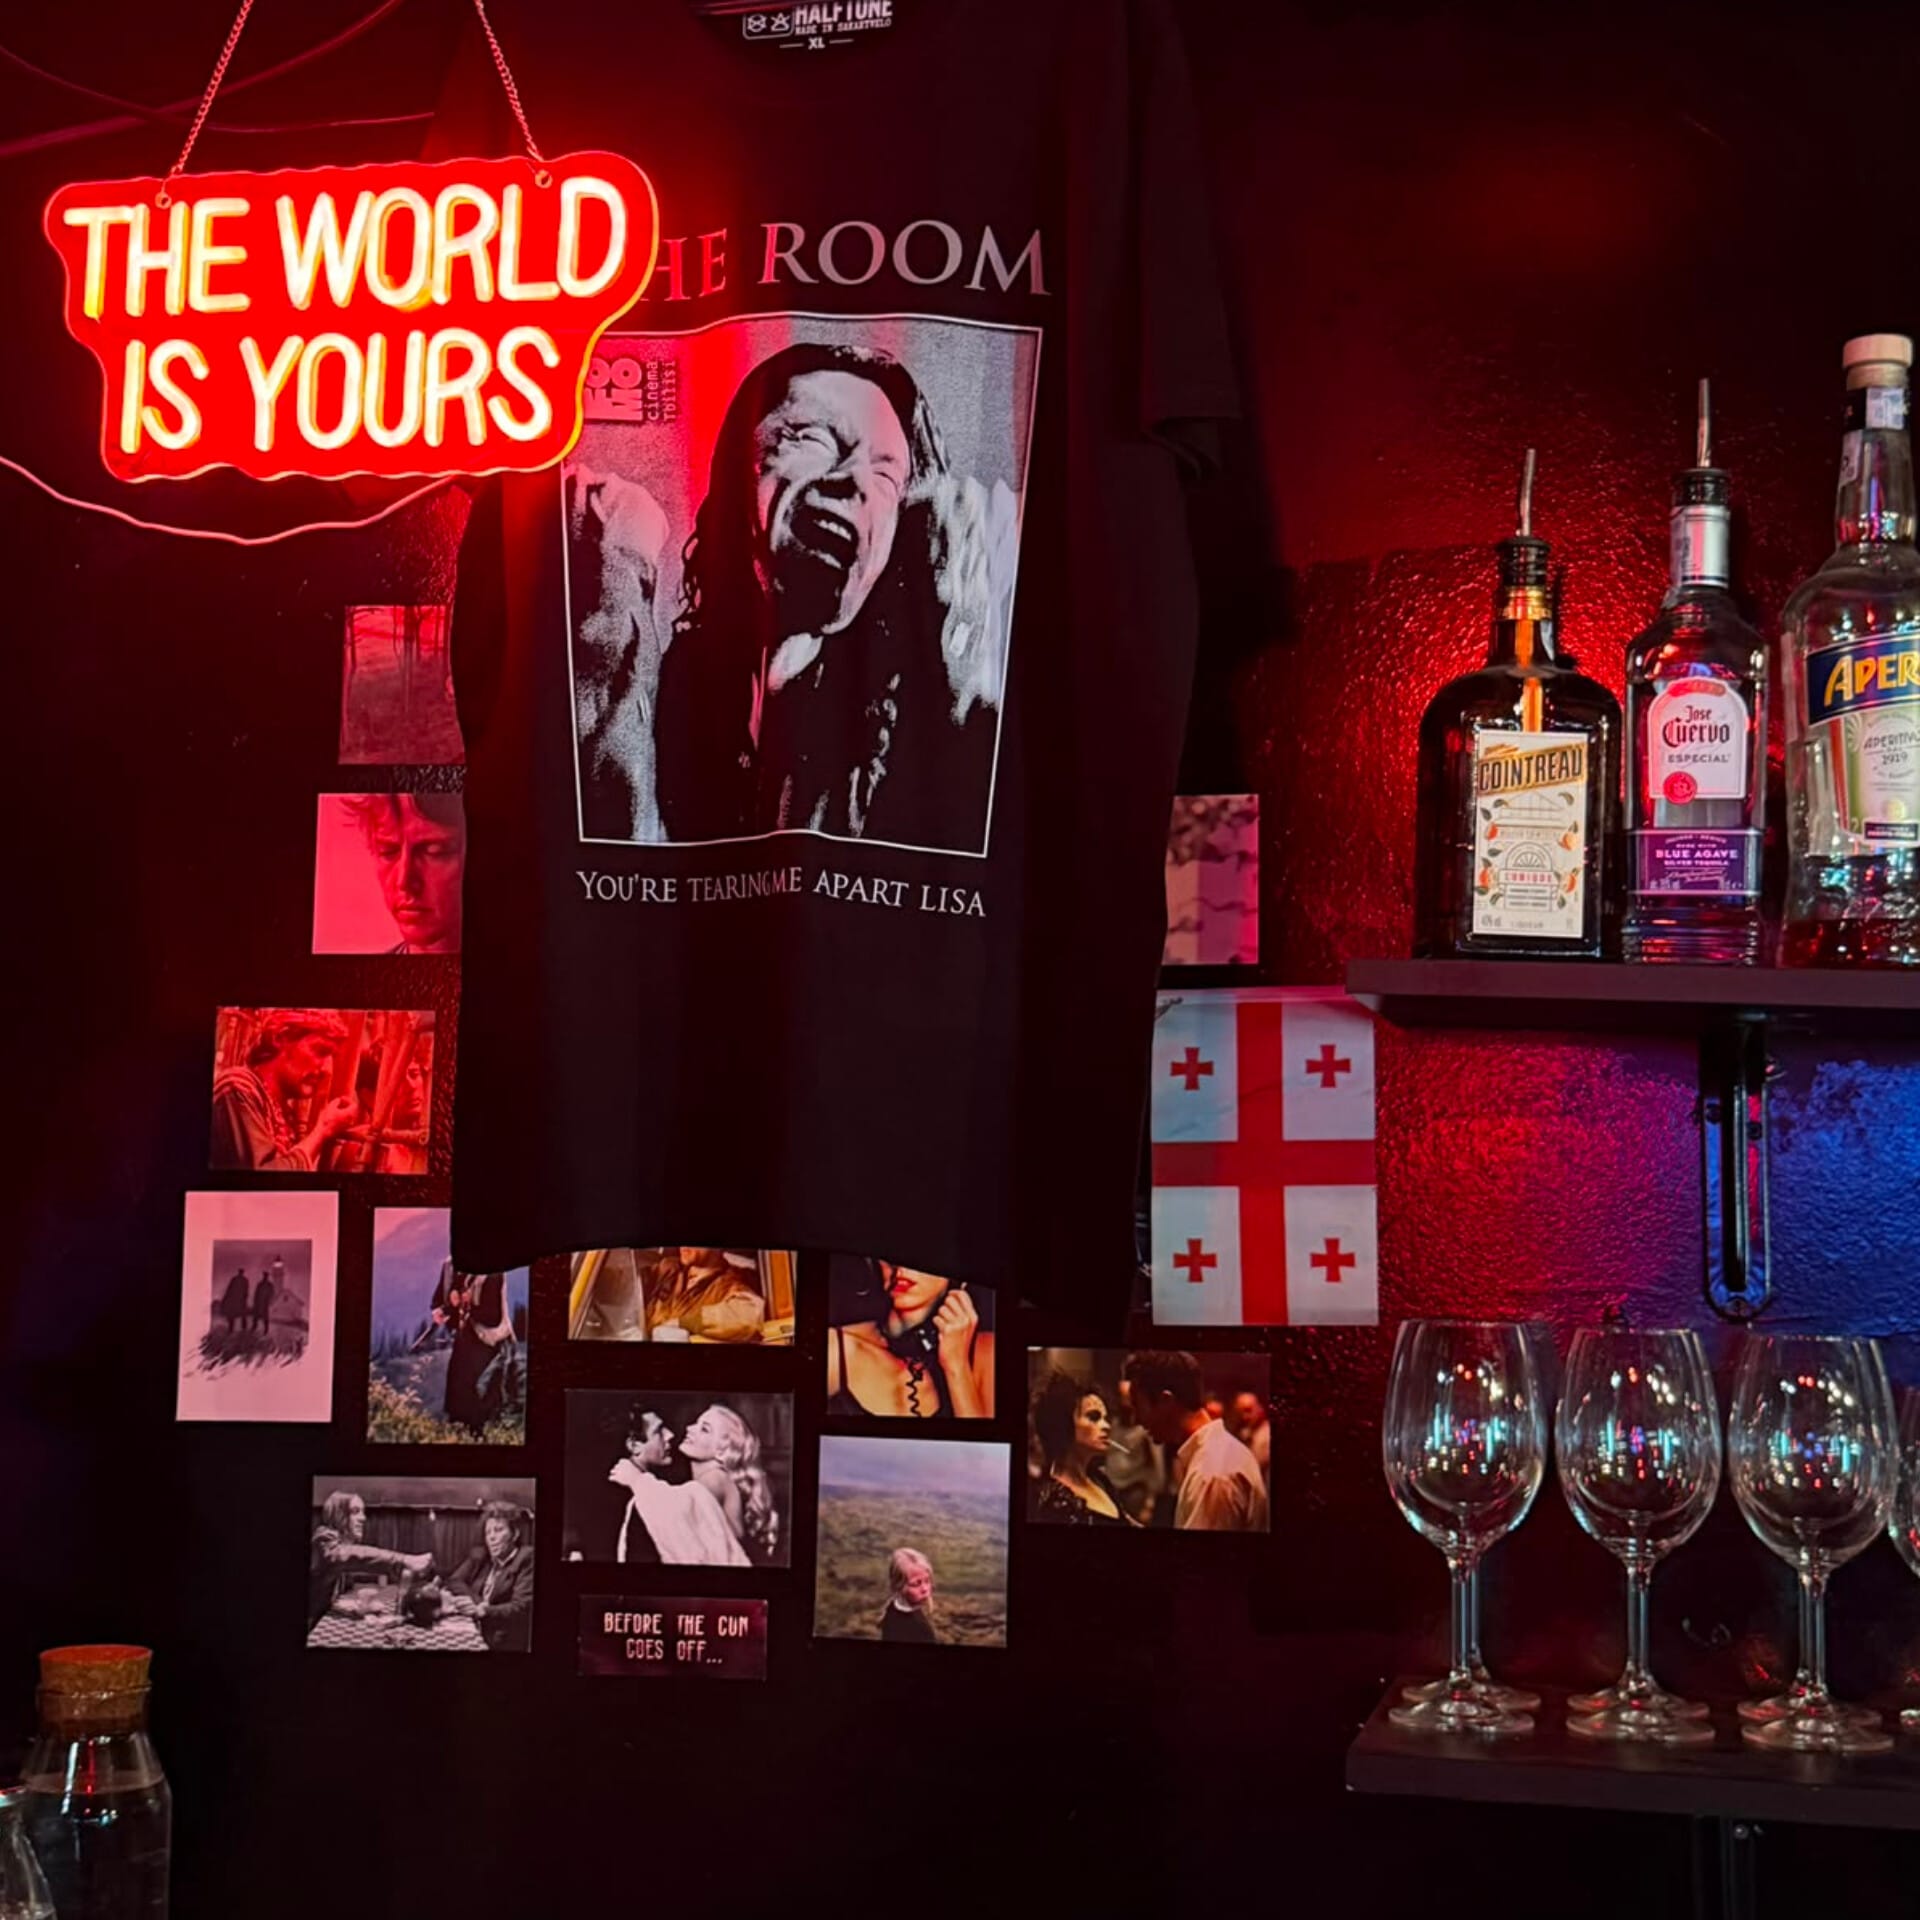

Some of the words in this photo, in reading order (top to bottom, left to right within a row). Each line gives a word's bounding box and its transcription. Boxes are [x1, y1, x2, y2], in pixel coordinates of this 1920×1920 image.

[808, 37, 826, 50] XL
[822, 23, 834, 33] IN
[63, 197, 251, 320] THE
[275, 176, 628, 312] WORLD
[640, 227, 728, 301] HE
[757, 219, 1052, 297] ROOM
[120, 338, 210, 454] IS
[238, 325, 561, 453] YOURS
[645, 360, 659, 421] cinema
[661, 360, 677, 421] Tbilisi
[1662, 717, 1731, 748] Cuervo
[1686, 705, 1712, 723] Jose
[1478, 749, 1583, 792] COINTREAU
[1667, 754, 1729, 763] ESPECIAL
[1655, 849, 1691, 859] BLUE
[1693, 849, 1738, 859] AGAVE
[576, 871, 678, 903] YOU'RE
[687, 871, 770, 902] TEARING
[813, 869, 910, 908] APART
[920, 885, 987, 917] LISA
[603, 1612, 663, 1634] BEFORE
[677, 1614, 705, 1636] THE
